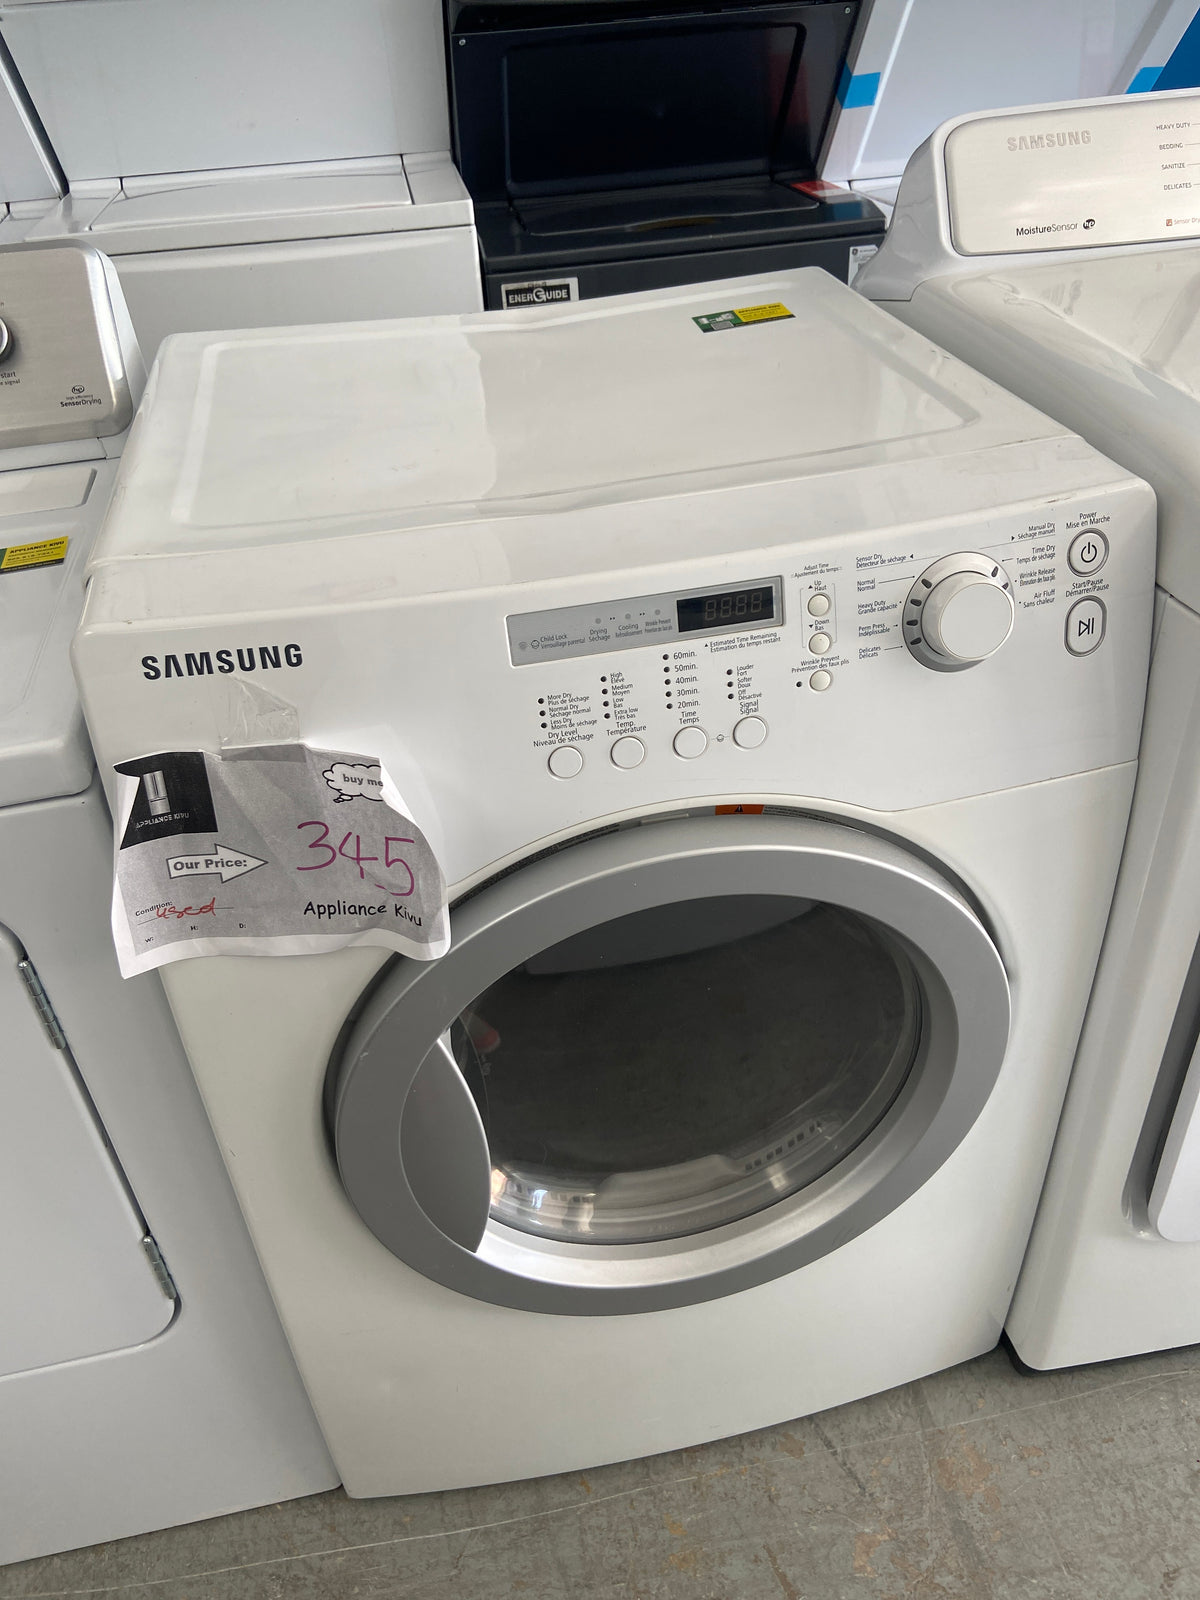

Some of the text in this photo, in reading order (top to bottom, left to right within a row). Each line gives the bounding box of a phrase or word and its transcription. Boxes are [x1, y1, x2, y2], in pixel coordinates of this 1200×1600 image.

[1007, 130, 1092, 151] SAMSUNG
[1016, 222, 1078, 236] MoistureSensor
[509, 288, 568, 304] ENERGUIDE
[60, 398, 102, 407] SensorDrying
[1079, 512, 1097, 520] Power
[1089, 515, 1110, 525] Marche
[1028, 523, 1045, 532] Manual
[1018, 528, 1055, 540] Séchage manuel
[887, 555, 906, 563] séchage
[1038, 552, 1056, 560] séchage
[794, 570, 818, 579] Ajustement
[826, 566, 839, 574] temps
[1072, 578, 1103, 590] Start/Pause
[1043, 589, 1056, 597] Fluff
[1066, 584, 1109, 597] Démarrer/Pause
[1024, 597, 1055, 609] Sans chaleur
[590, 628, 607, 636] Drying
[618, 623, 639, 632] Cooling
[540, 635, 554, 643] Child
[589, 634, 611, 643] Séchage
[710, 638, 735, 647] Estimated
[750, 632, 777, 641] Remaining
[710, 644, 738, 653] Estimation
[746, 640, 760, 648] temps
[761, 637, 781, 645] restant
[673, 651, 697, 660] 60min.
[141, 643, 303, 680] SAMSUNG
[674, 663, 698, 672] 50min.
[675, 675, 698, 685] 40min.
[677, 688, 699, 697] 30min.
[549, 705, 568, 713] Normal
[678, 699, 700, 709] 20min.
[739, 699, 759, 709] Signal
[550, 707, 591, 719] Séchage normal
[682, 710, 697, 718] Time
[740, 706, 759, 716] Signal
[576, 719, 597, 727] séchage
[616, 720, 636, 728] Temp.
[679, 716, 699, 725] Temps
[548, 728, 578, 739] Dry Level
[606, 724, 647, 736] Température
[534, 739, 556, 748] Niveau
[567, 733, 594, 742] séchage
[343, 774, 363, 786] buy
[135, 815, 172, 828] APPLIANCE
[297, 820, 415, 896] 345
[173, 858, 248, 871] Our Price:
[135, 901, 173, 917] Condition:
[156, 897, 216, 919] used
[303, 900, 422, 927] Appliance Kivu
